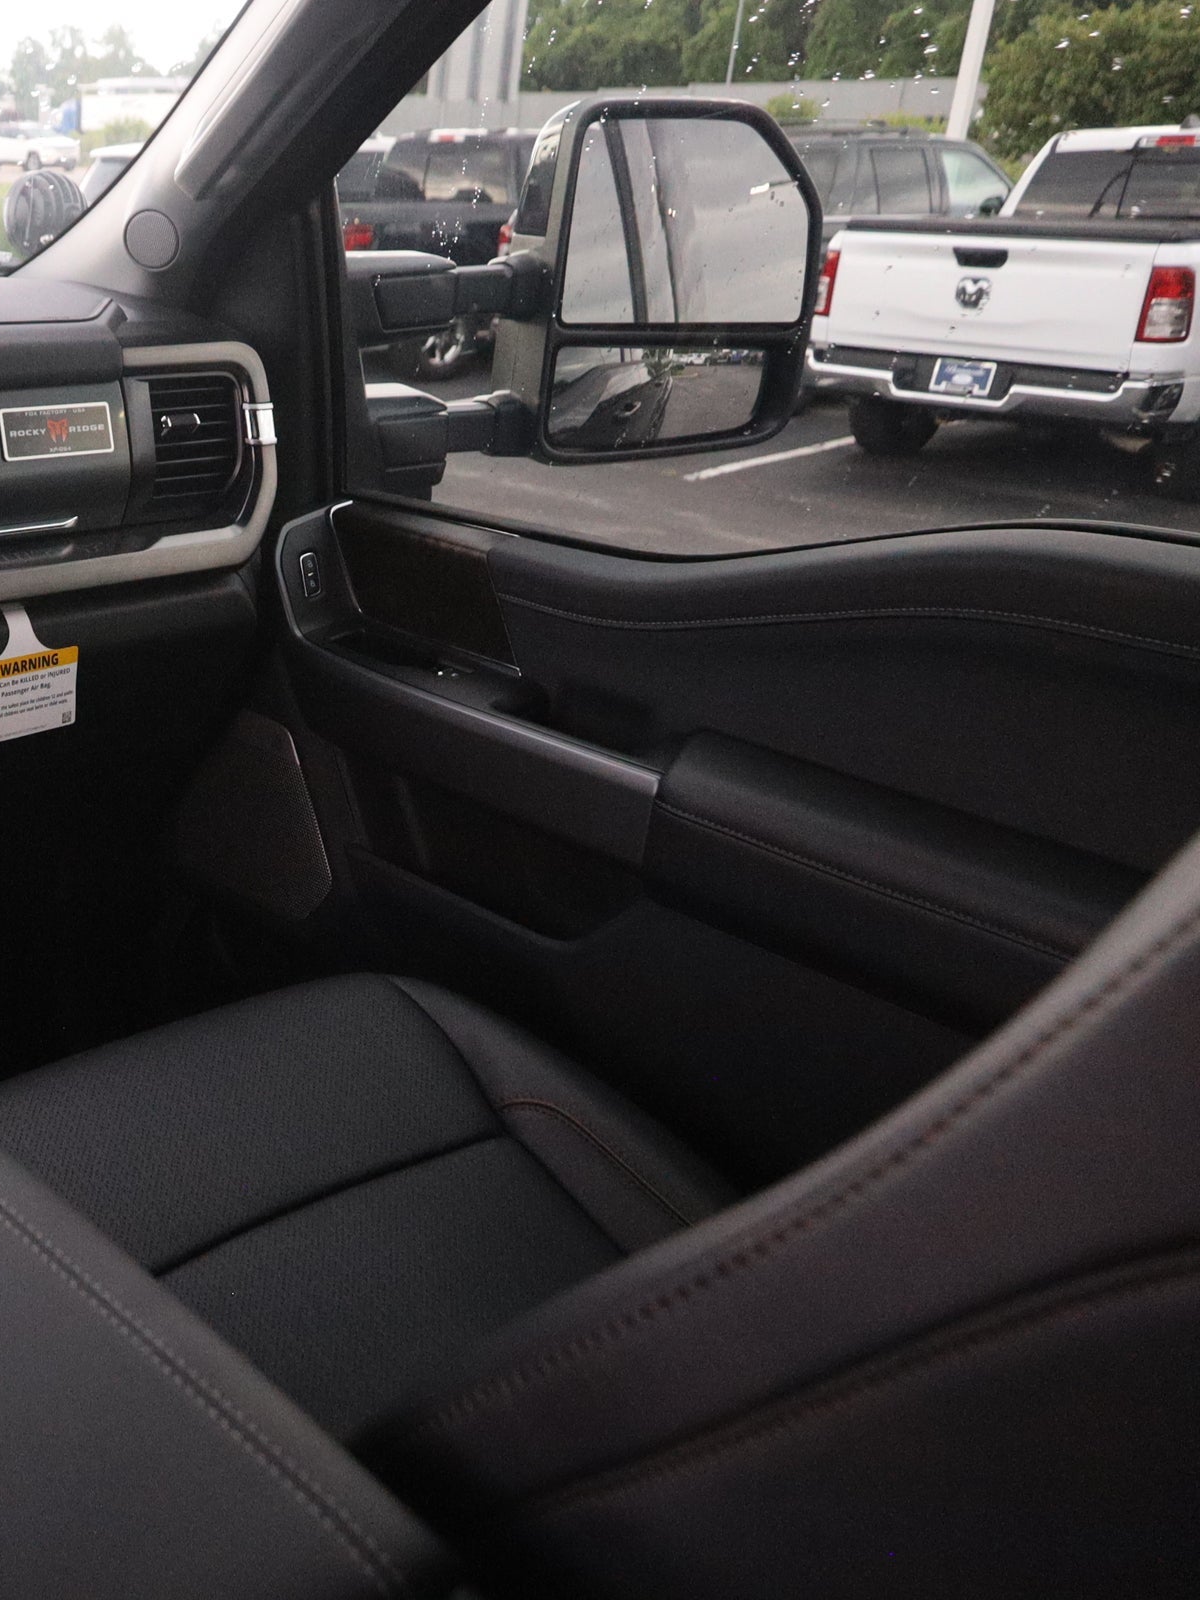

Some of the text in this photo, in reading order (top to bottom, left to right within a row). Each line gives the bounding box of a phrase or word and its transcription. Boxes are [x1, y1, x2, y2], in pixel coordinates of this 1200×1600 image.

[9, 424, 105, 438] ROCKY RIDGE
[0, 653, 59, 677] WARNING
[0, 681, 10, 689] Can
[12, 680, 19, 688] Be
[20, 674, 40, 684] KILLED
[48, 668, 71, 678] INJURED
[0, 686, 30, 699] Passenger
[30, 684, 40, 692] Air
[40, 682, 51, 690] Bag
